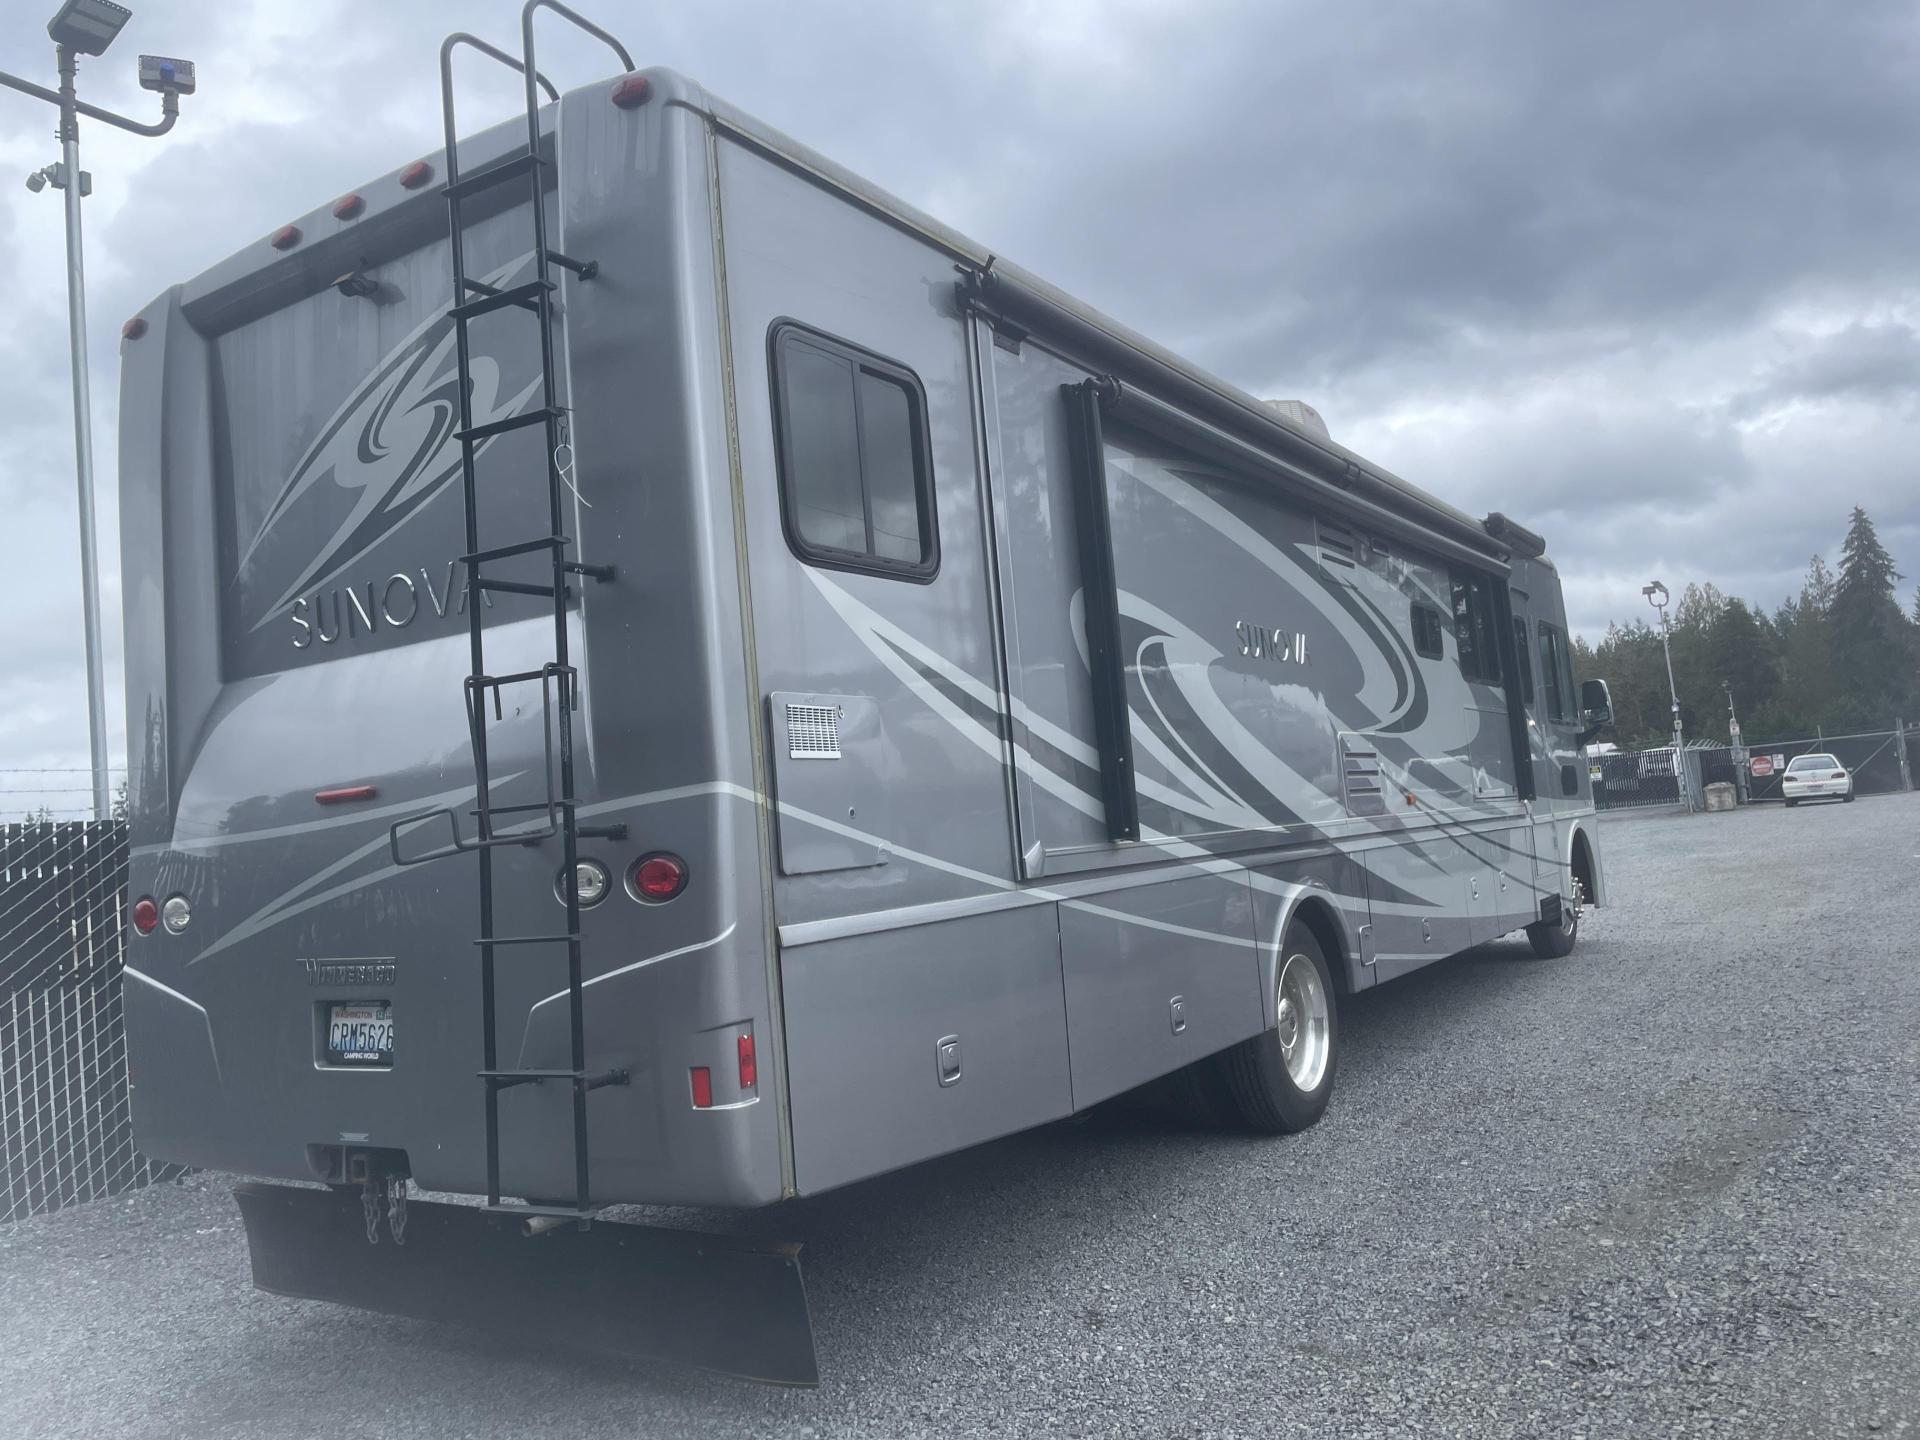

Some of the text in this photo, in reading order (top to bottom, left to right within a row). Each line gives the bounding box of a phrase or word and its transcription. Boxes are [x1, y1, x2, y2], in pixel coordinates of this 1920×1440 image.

[335, 1011, 373, 1020] WASHINGTON
[331, 1023, 393, 1051] CRM5626
[344, 1052, 379, 1060] CAMPING WORLD
